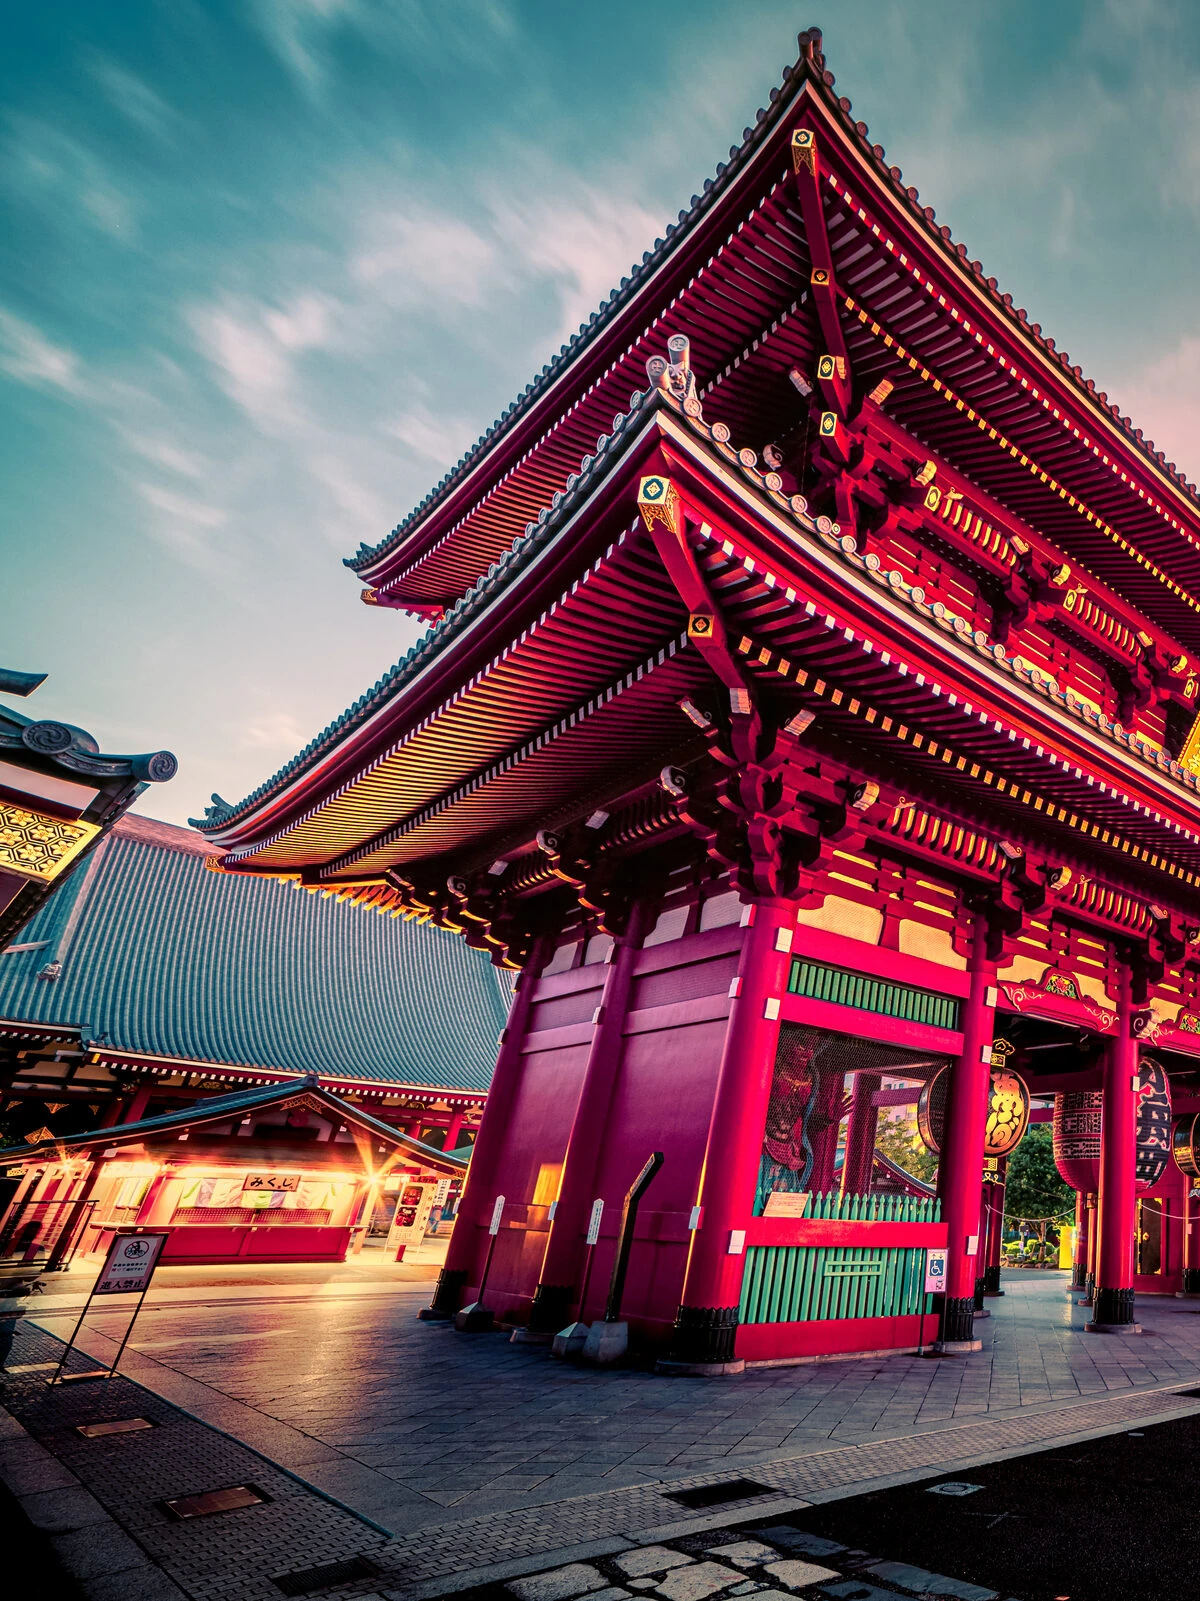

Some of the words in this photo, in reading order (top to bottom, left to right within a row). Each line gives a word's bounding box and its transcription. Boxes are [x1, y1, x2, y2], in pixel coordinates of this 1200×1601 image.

[250, 1177, 294, 1187] みくじ
[99, 1280, 145, 1289] 進入禁止
